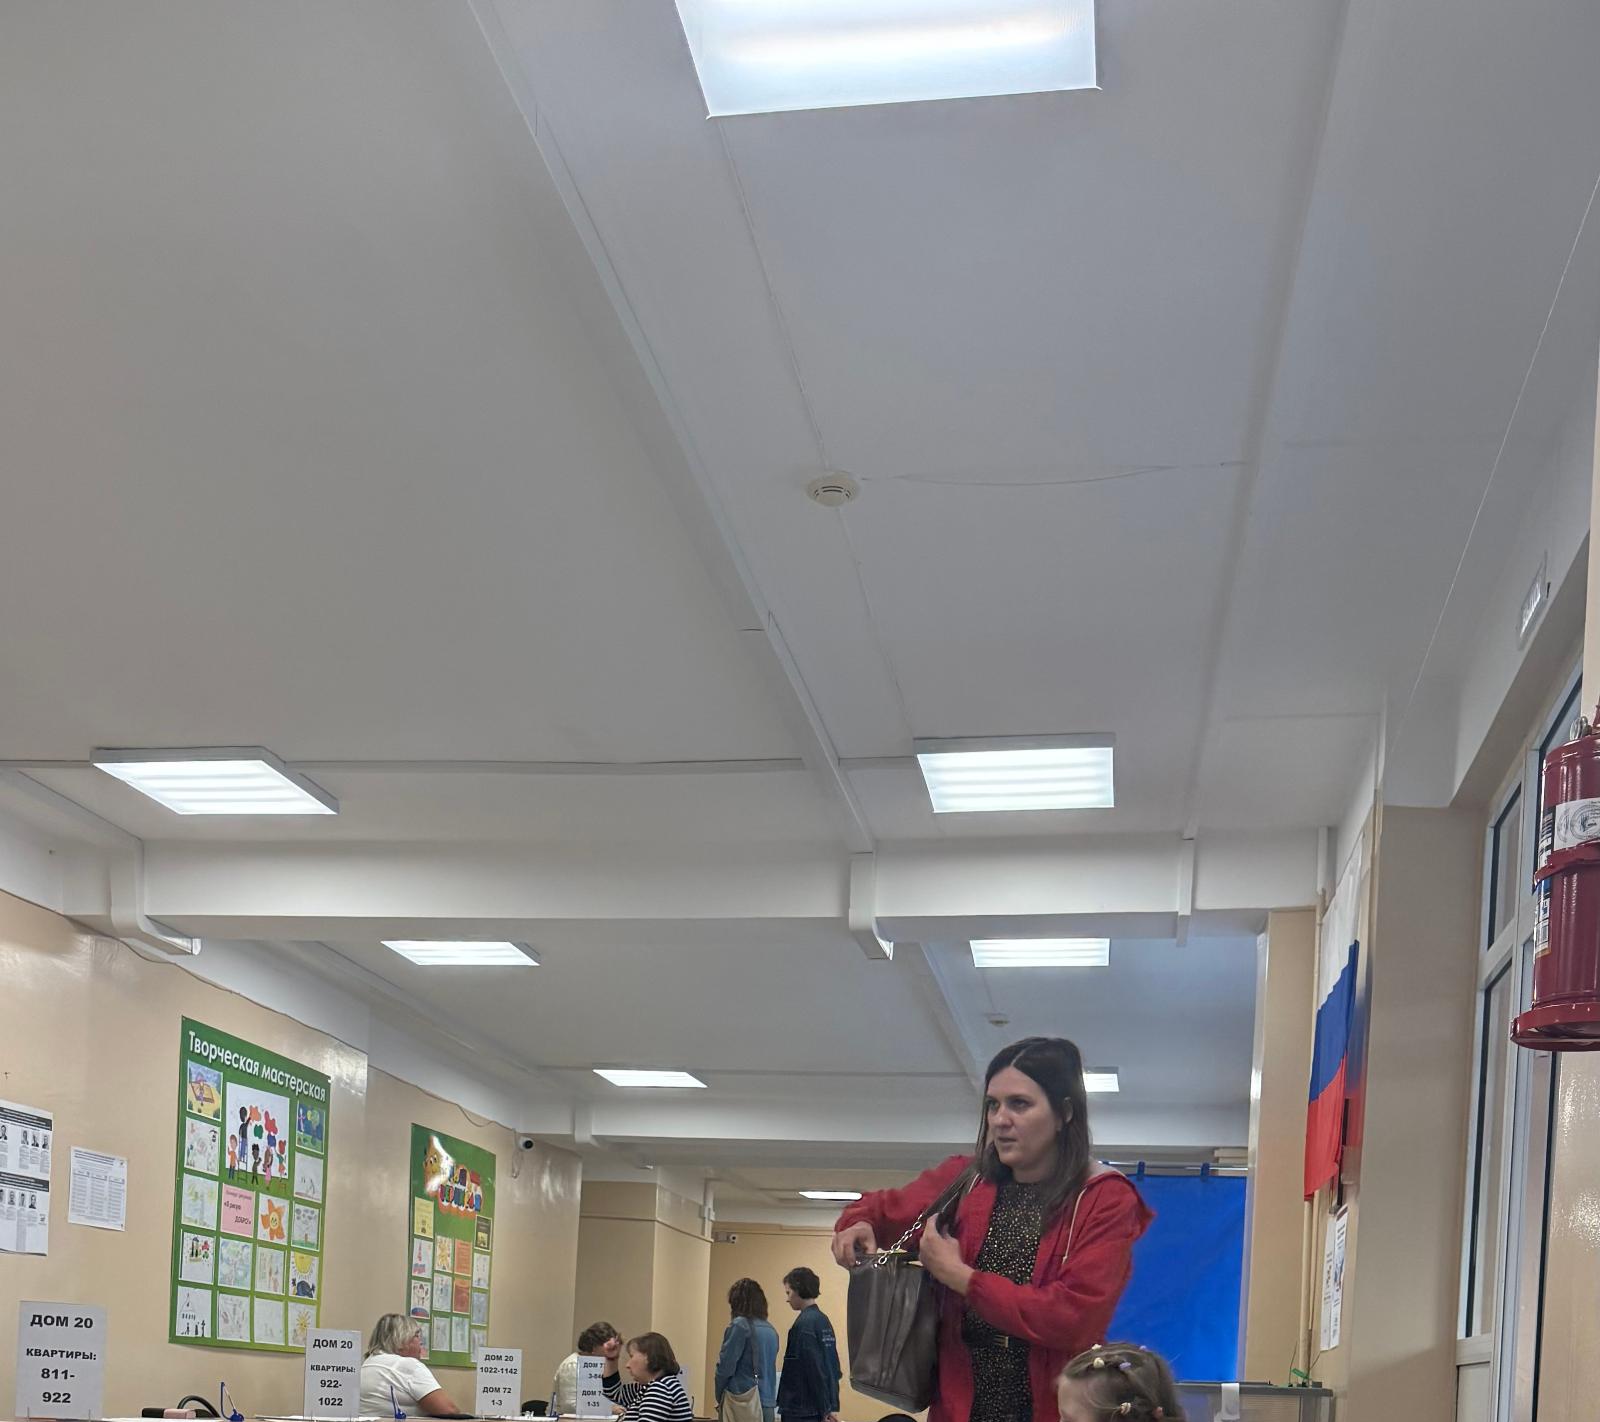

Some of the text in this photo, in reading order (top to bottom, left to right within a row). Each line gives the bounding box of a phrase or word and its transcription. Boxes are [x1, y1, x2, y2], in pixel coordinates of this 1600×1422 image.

[189, 1031, 326, 1102] Творческая мастерская
[30, 1314, 93, 1328] ДОМ 20
[313, 1339, 353, 1349] ДОМ 20
[26, 1348, 97, 1360] КВАРТИРЫ:
[310, 1364, 356, 1373] КВАРТИРЫ:
[480, 1366, 518, 1375] 1022-1142
[41, 1368, 75, 1380] 811-
[320, 1379, 342, 1388] 922-
[482, 1386, 500, 1394] ДОМ
[42, 1391, 71, 1403] 922
[318, 1397, 343, 1406] 1022
